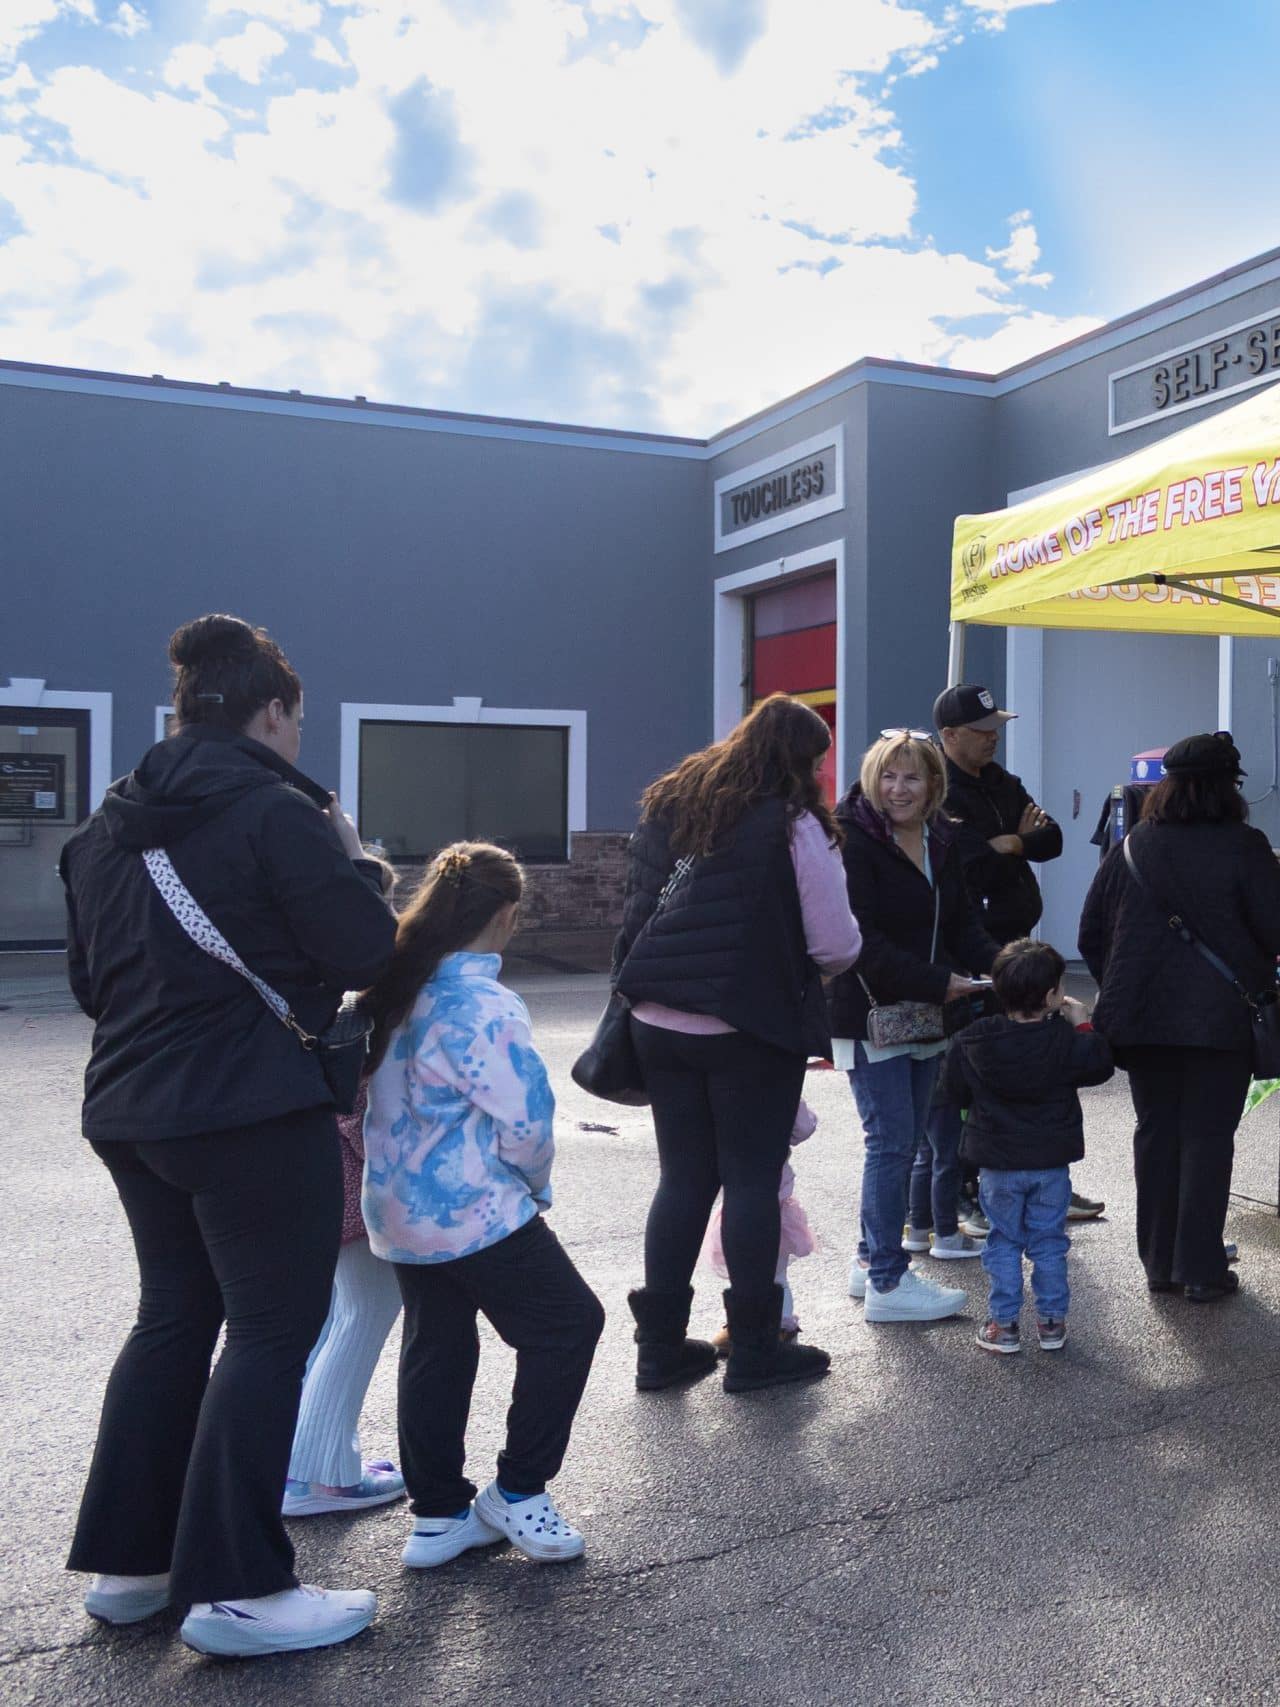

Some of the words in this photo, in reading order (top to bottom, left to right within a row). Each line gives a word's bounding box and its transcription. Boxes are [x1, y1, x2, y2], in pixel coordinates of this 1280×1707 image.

[730, 460, 825, 525] TOUCHLESS
[988, 528, 1063, 580] HOME
[1063, 507, 1104, 557] OF
[1105, 488, 1161, 544] THE
[1163, 465, 1250, 531] FREE
